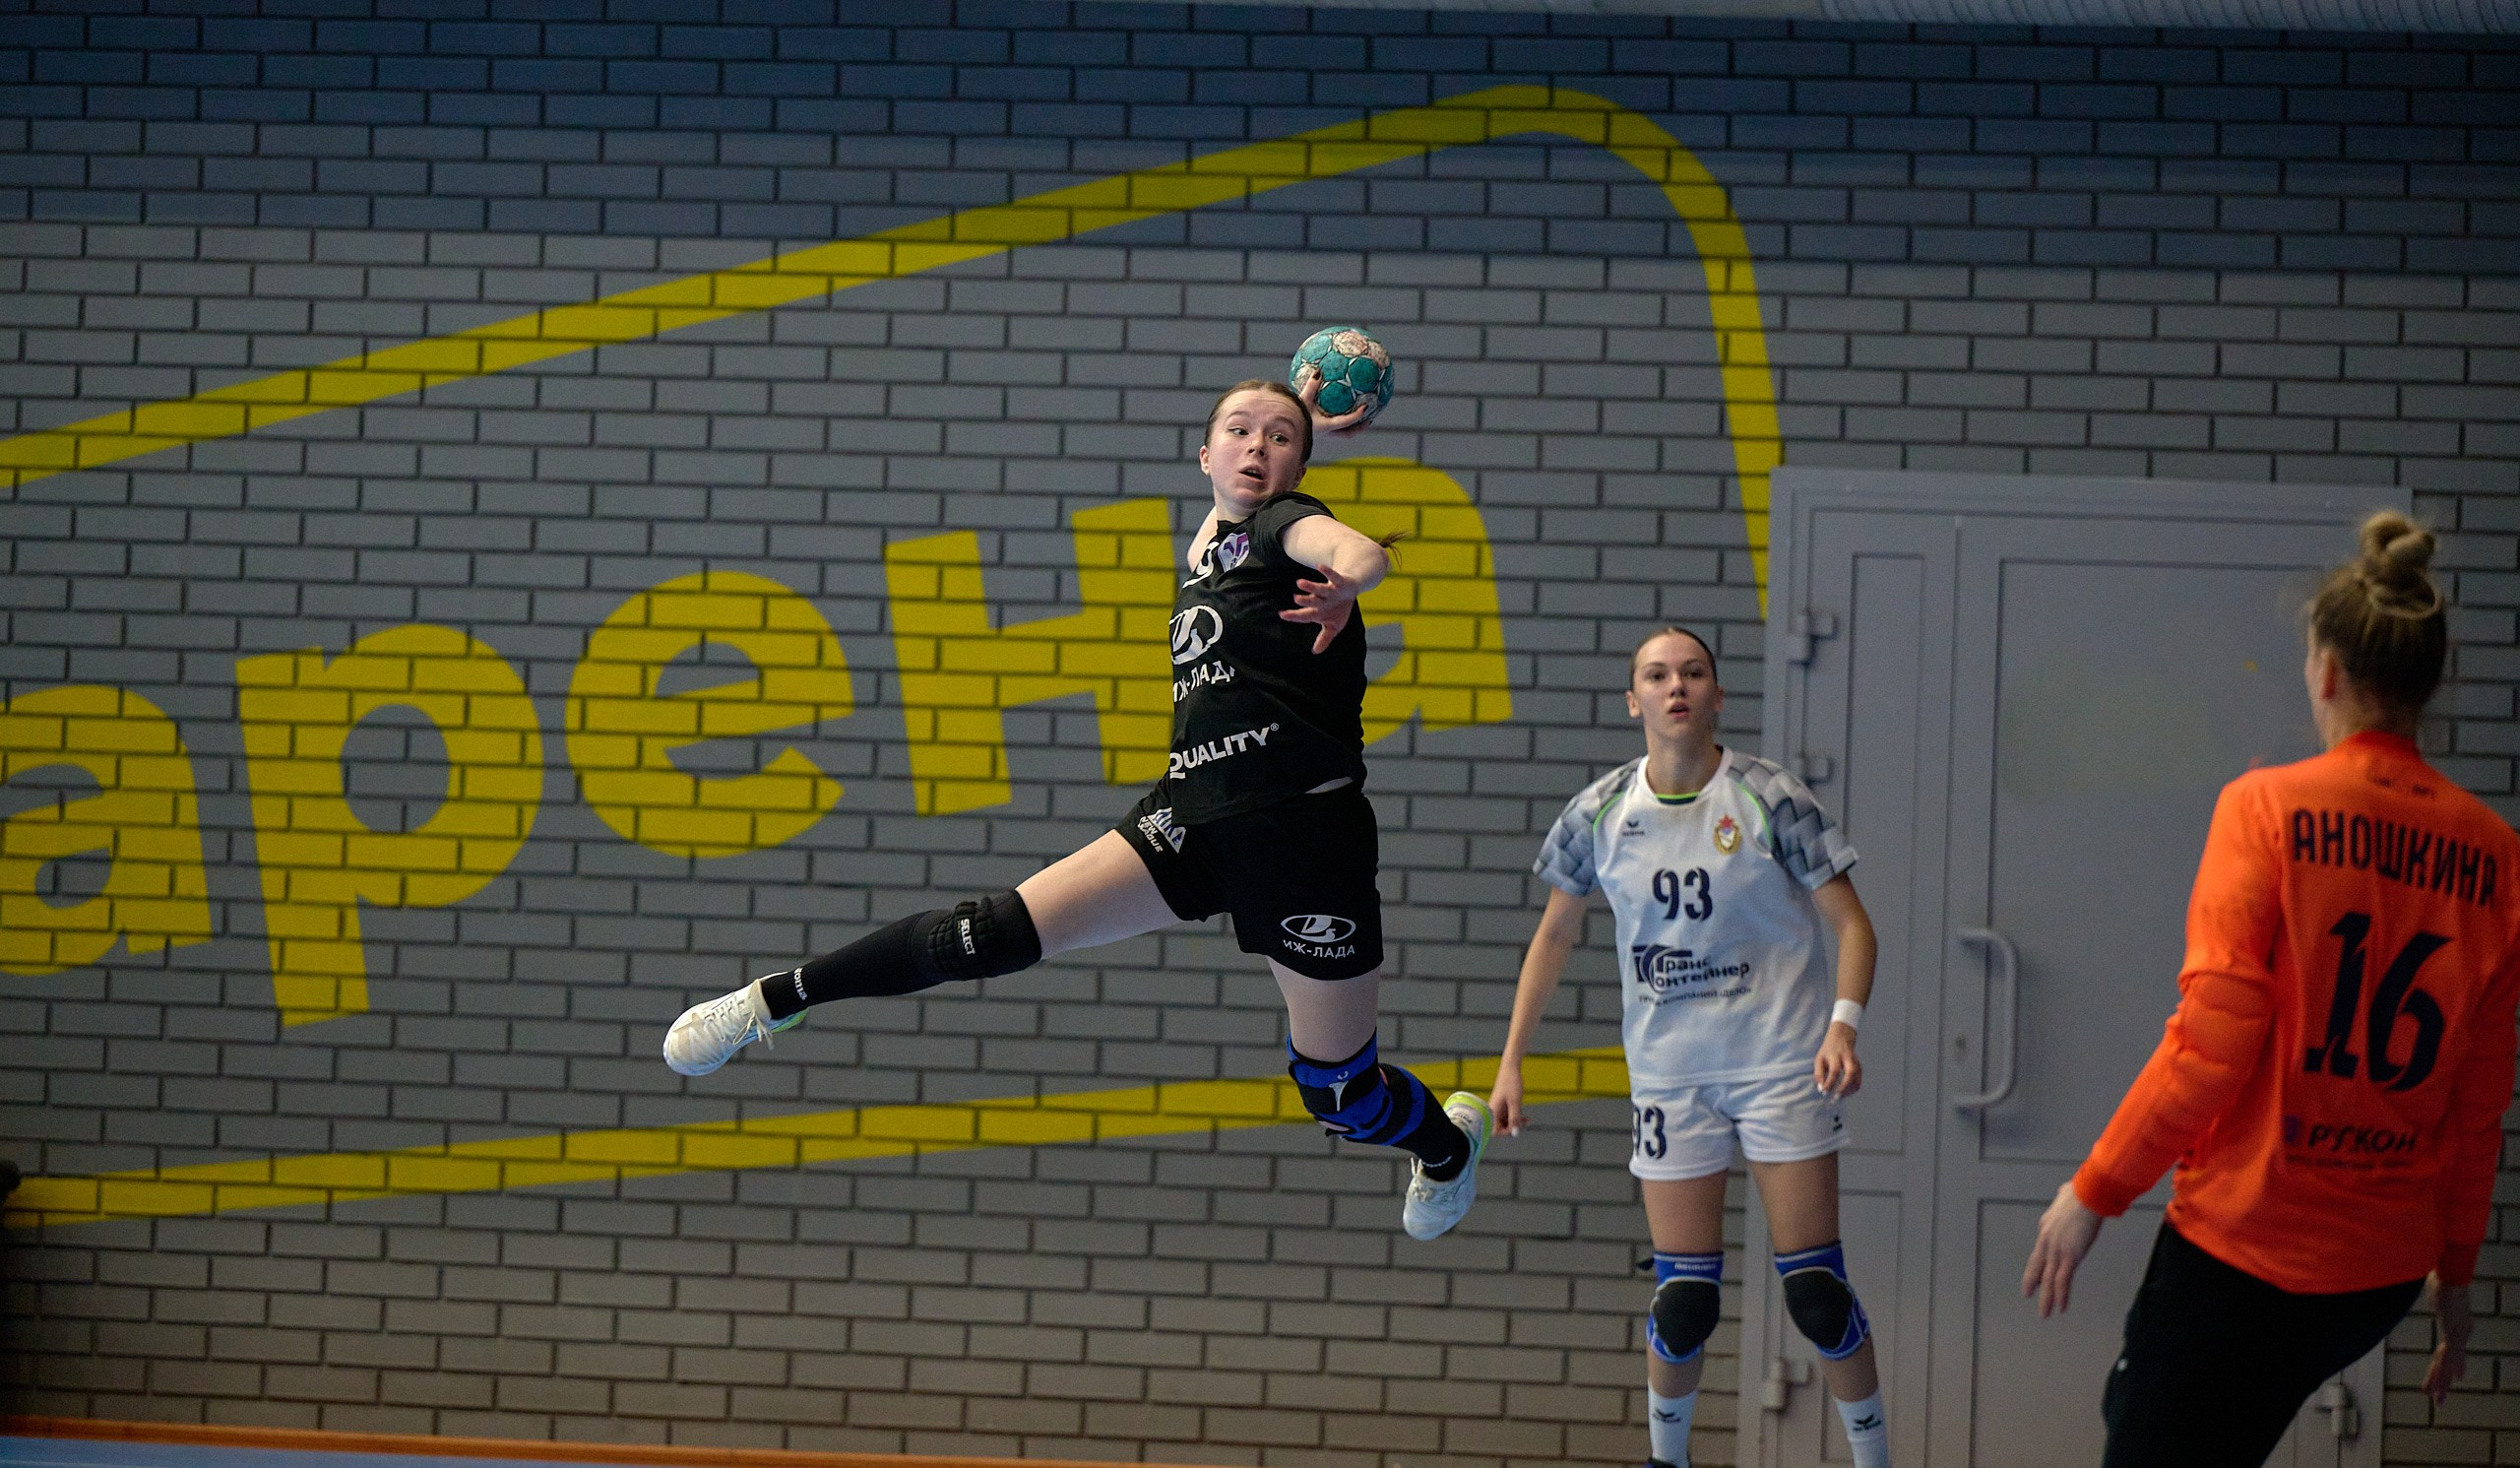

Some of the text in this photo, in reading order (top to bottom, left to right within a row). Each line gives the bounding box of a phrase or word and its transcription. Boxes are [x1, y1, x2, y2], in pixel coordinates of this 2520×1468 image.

[2293, 808, 2497, 908] АНОШКИНА
[1653, 867, 1713, 922] 93
[961, 918, 976, 955] SELECT
[1283, 938, 1355, 960] ИЖ-ЛАДА
[2303, 911, 2453, 1092] 16
